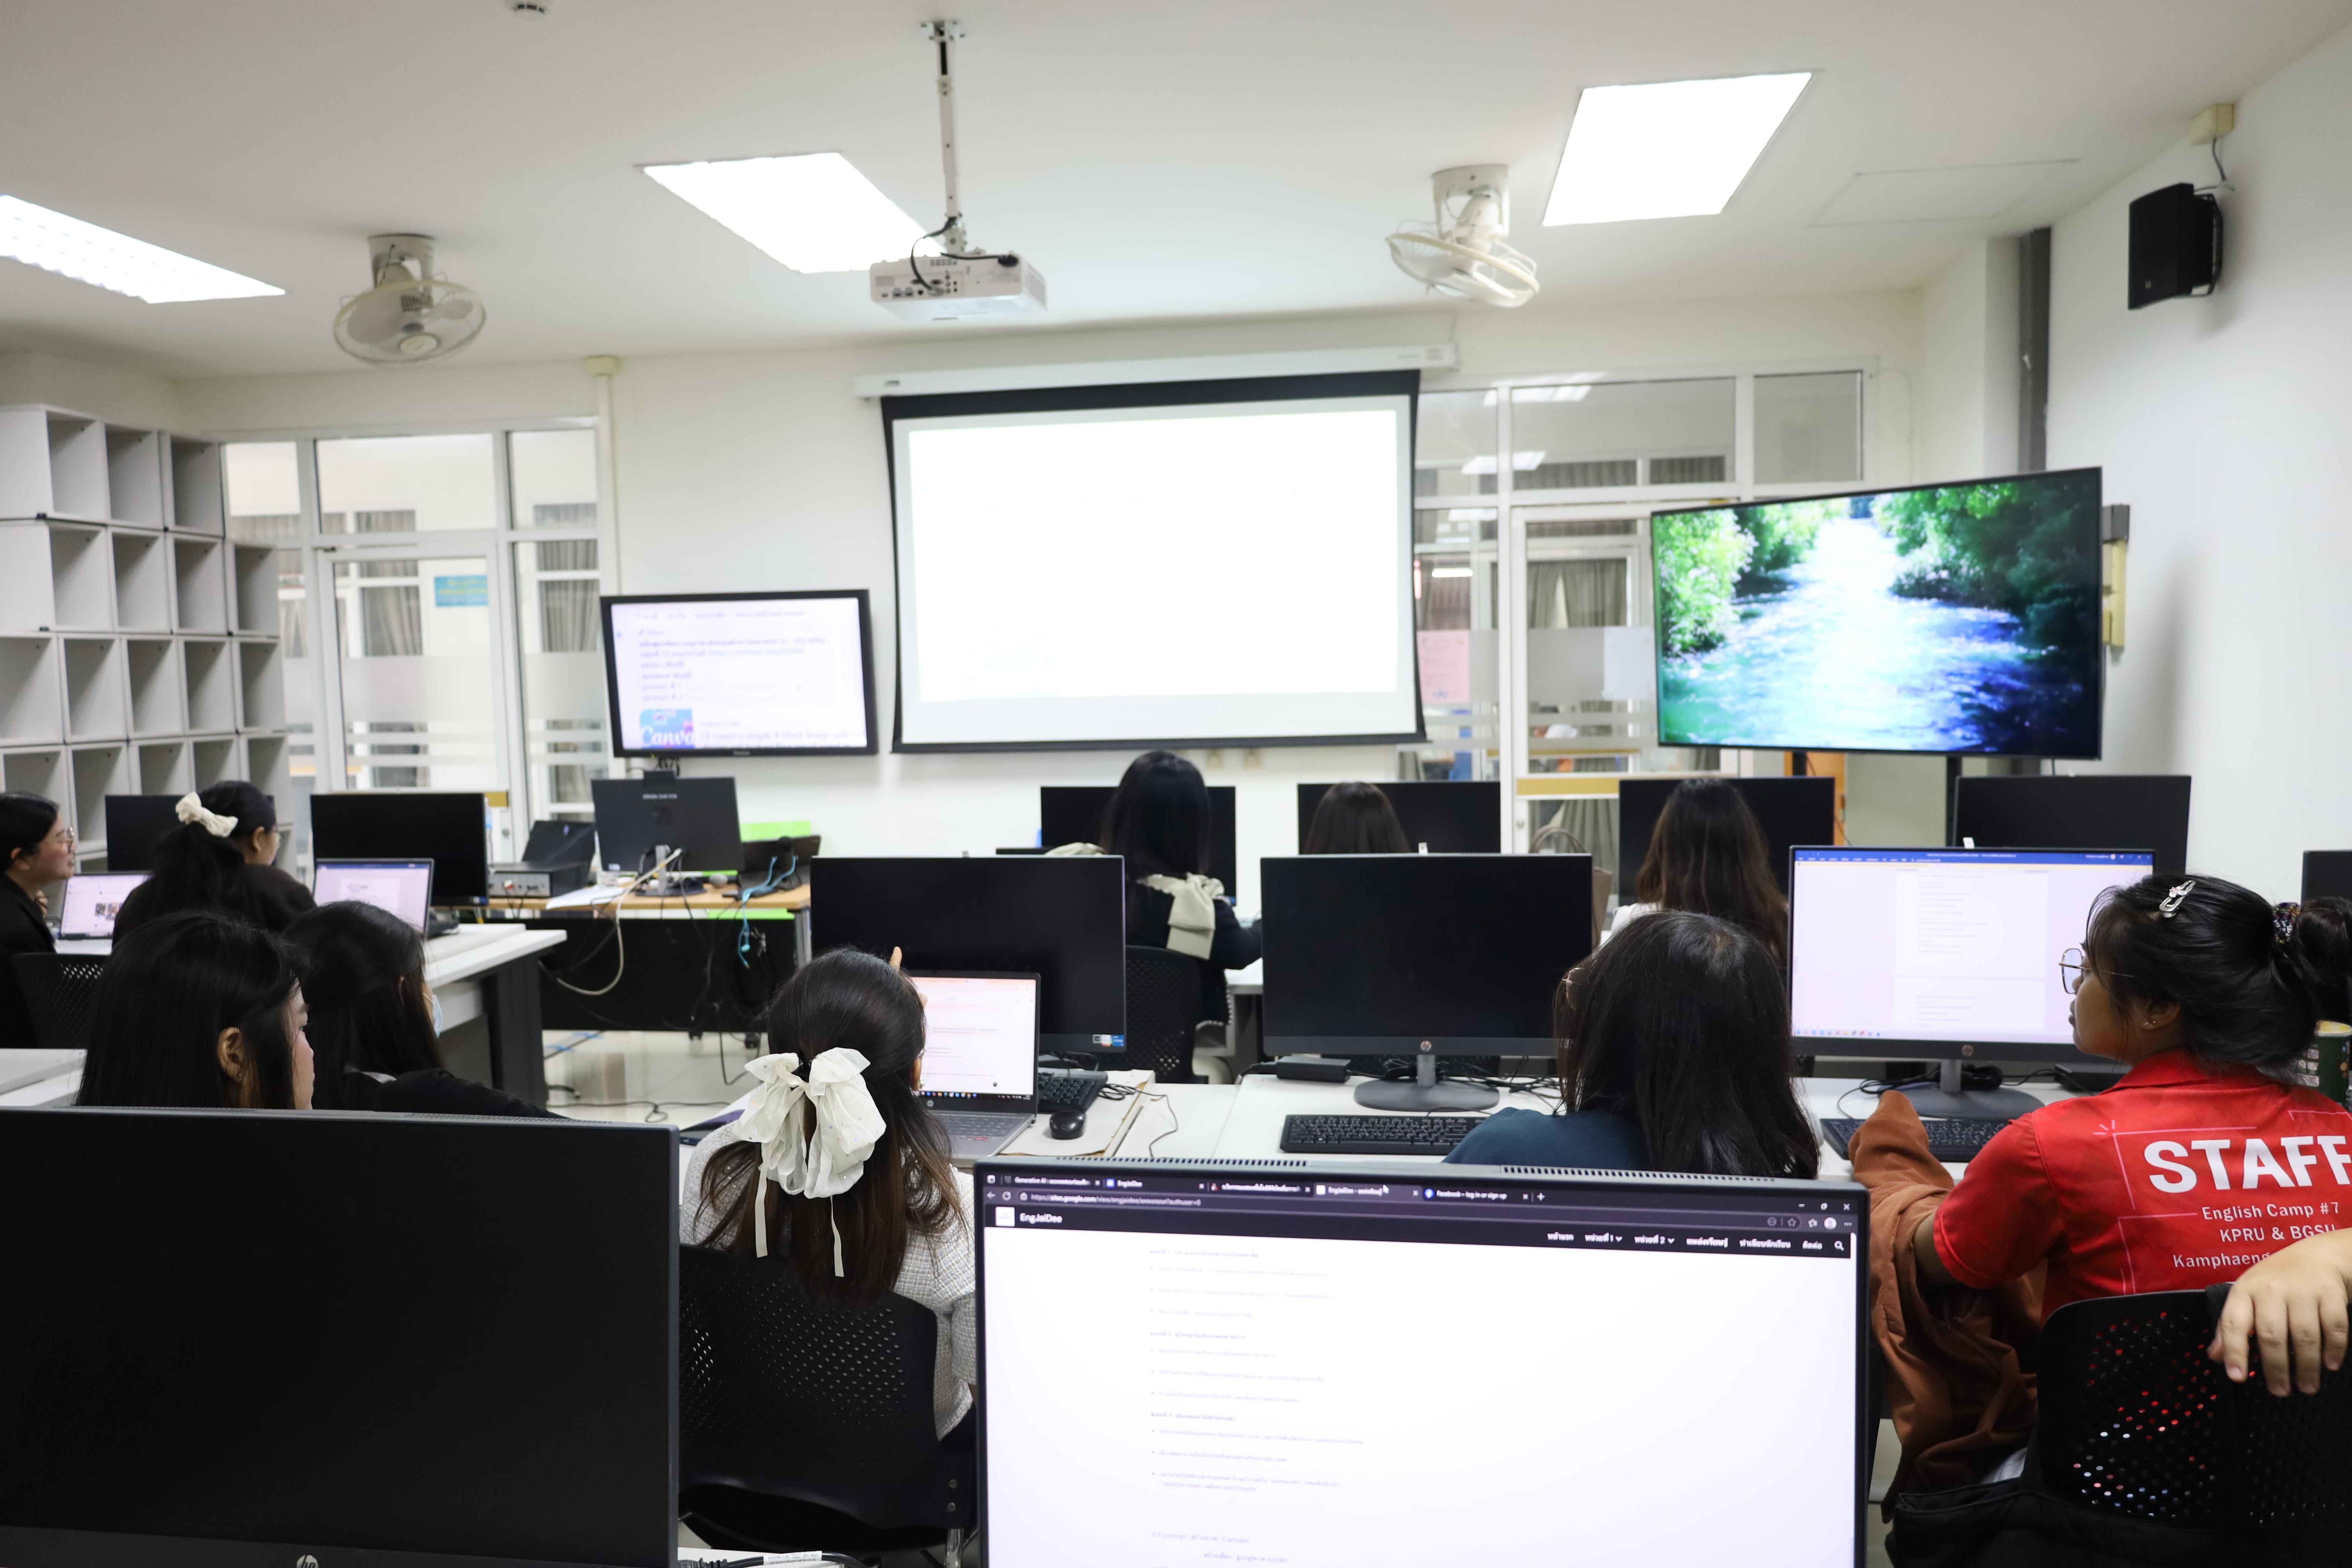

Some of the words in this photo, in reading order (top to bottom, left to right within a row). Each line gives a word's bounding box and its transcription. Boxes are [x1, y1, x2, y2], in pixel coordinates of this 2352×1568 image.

[640, 724, 694, 747] Canva
[2144, 1136, 2352, 1193] STAFF
[2202, 1204, 2262, 1222] English
[2266, 1202, 2314, 1218] Camp
[2220, 1227, 2265, 1243] KPRU
[2271, 1227, 2285, 1240] &
